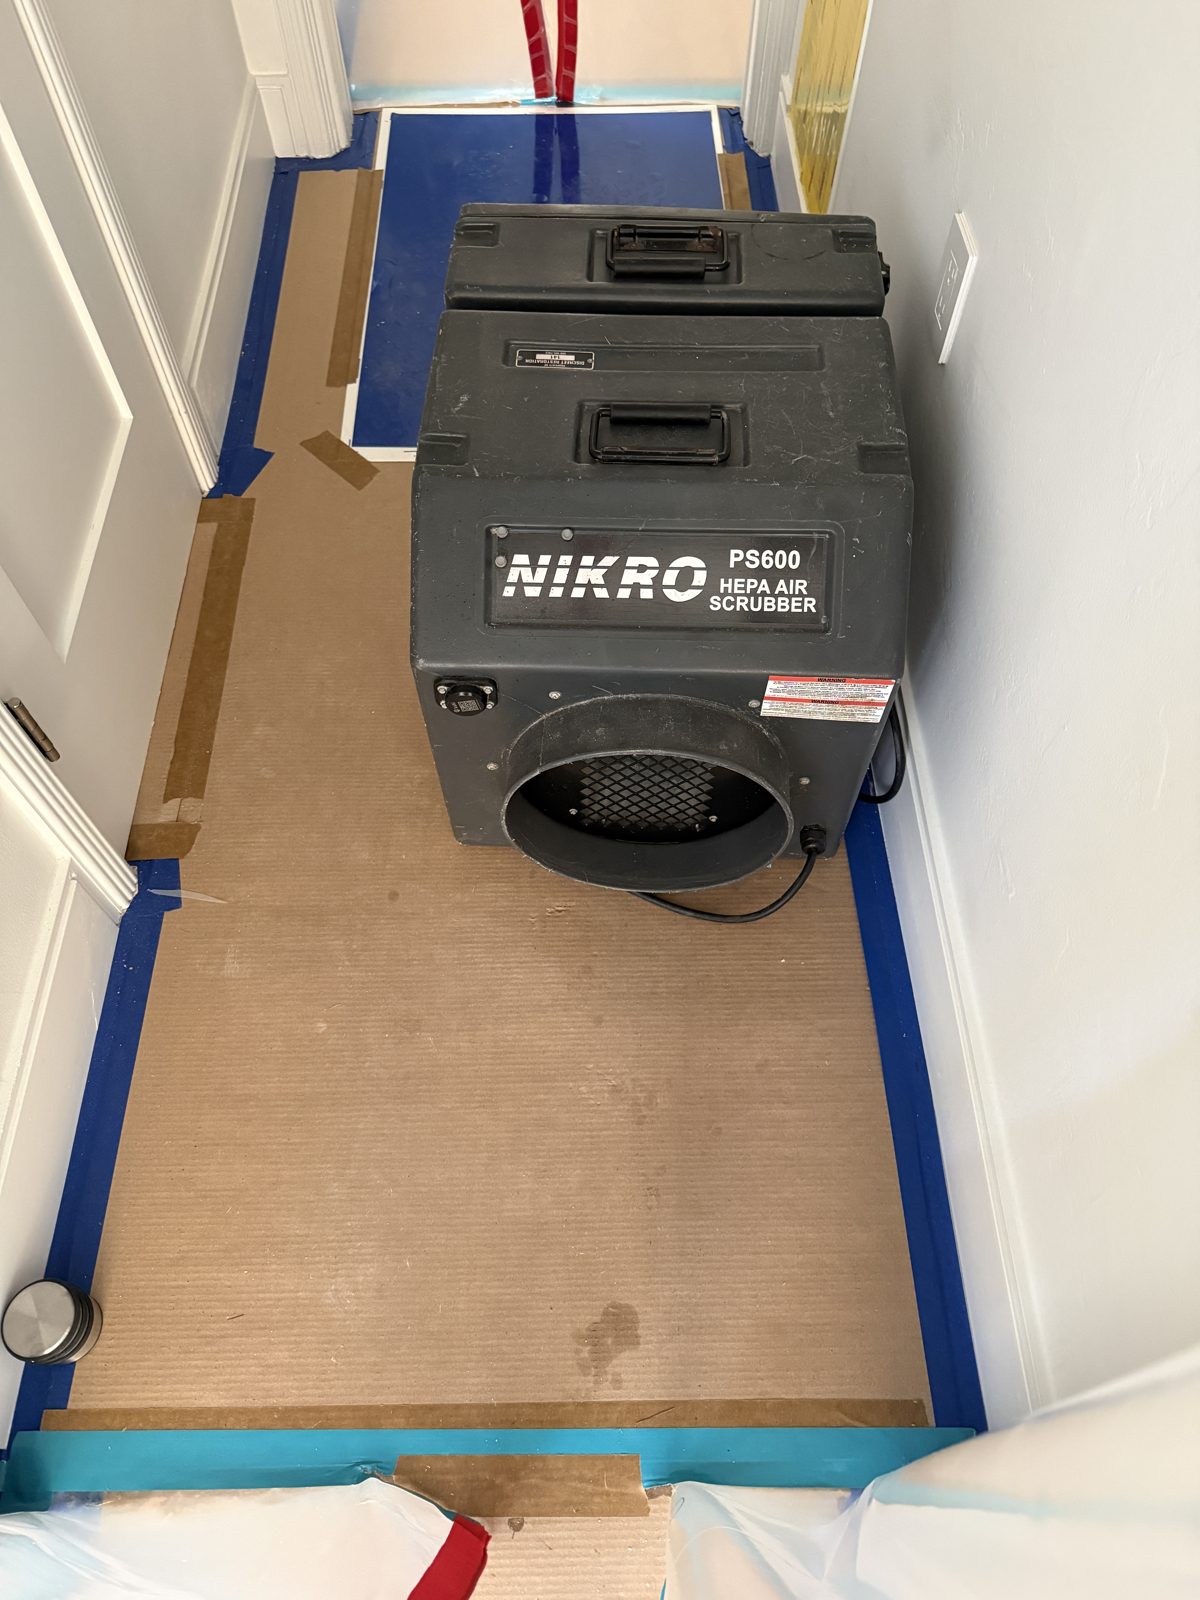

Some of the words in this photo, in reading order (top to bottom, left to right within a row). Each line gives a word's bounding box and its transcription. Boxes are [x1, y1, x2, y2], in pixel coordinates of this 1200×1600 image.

[729, 549, 801, 570] PS600
[502, 553, 707, 604] NIKRO
[719, 578, 771, 595] HEPA
[774, 579, 808, 595] AIR
[708, 596, 817, 613] SCRUBBER
